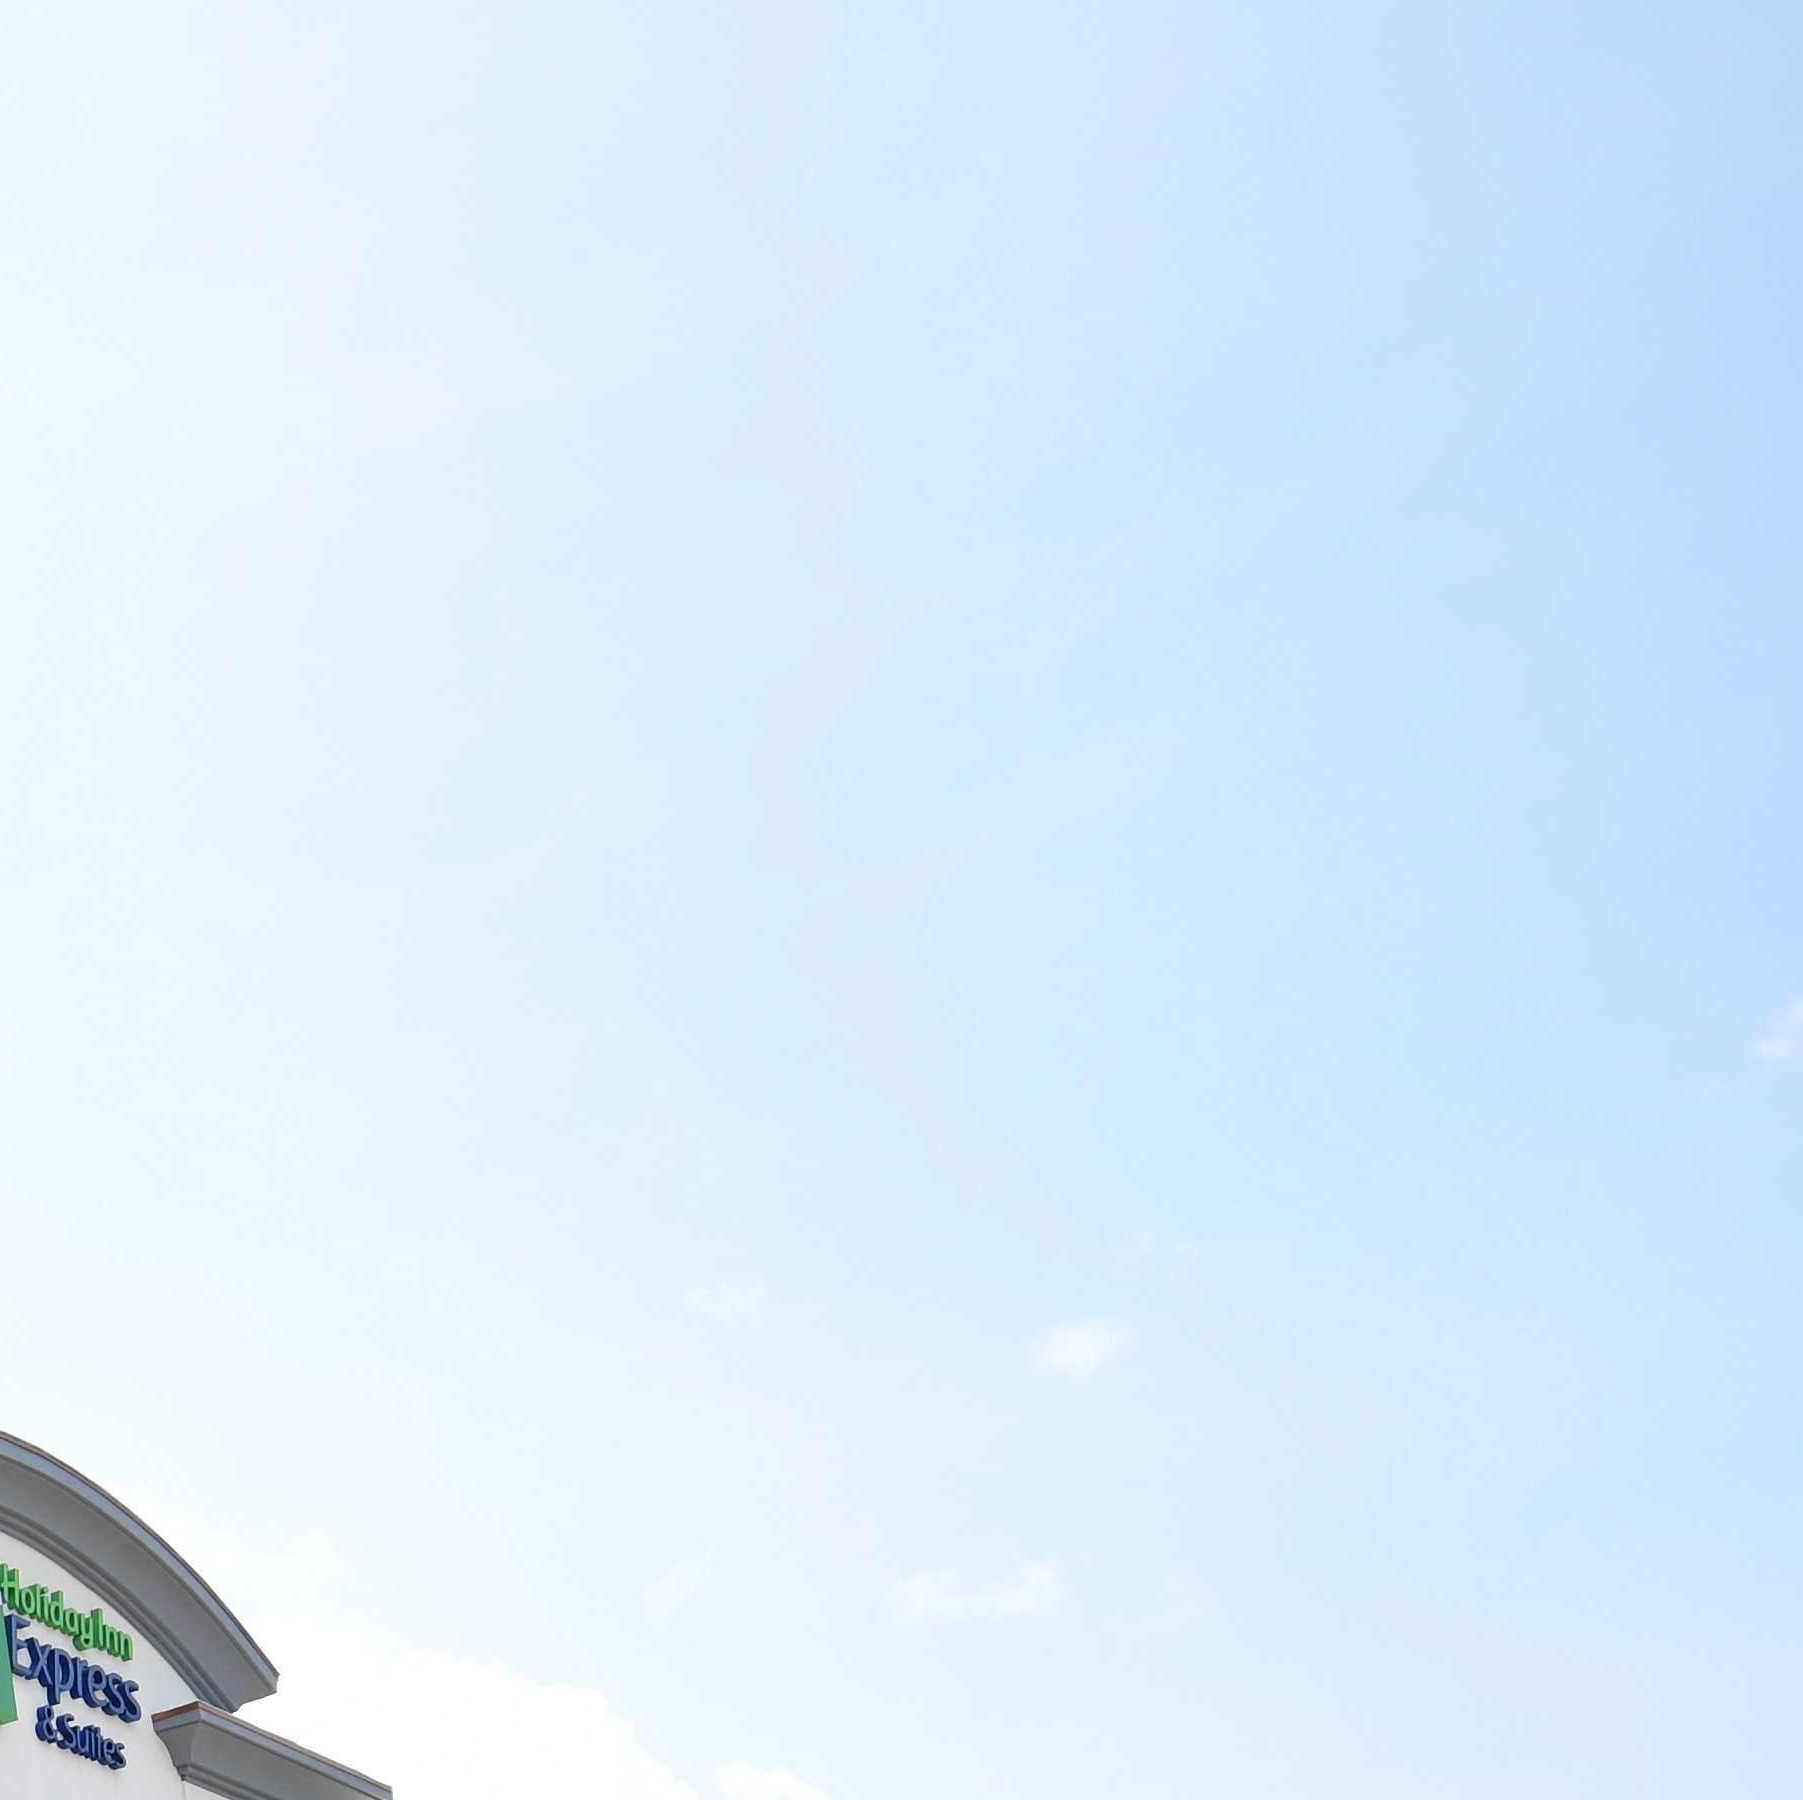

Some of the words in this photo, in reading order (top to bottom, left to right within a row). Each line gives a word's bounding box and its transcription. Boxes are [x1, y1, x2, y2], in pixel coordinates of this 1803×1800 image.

[91, 1607, 134, 1661] Inn
[4, 1614, 142, 1723] Express
[35, 1704, 58, 1744] &
[56, 1713, 127, 1770] Suites
